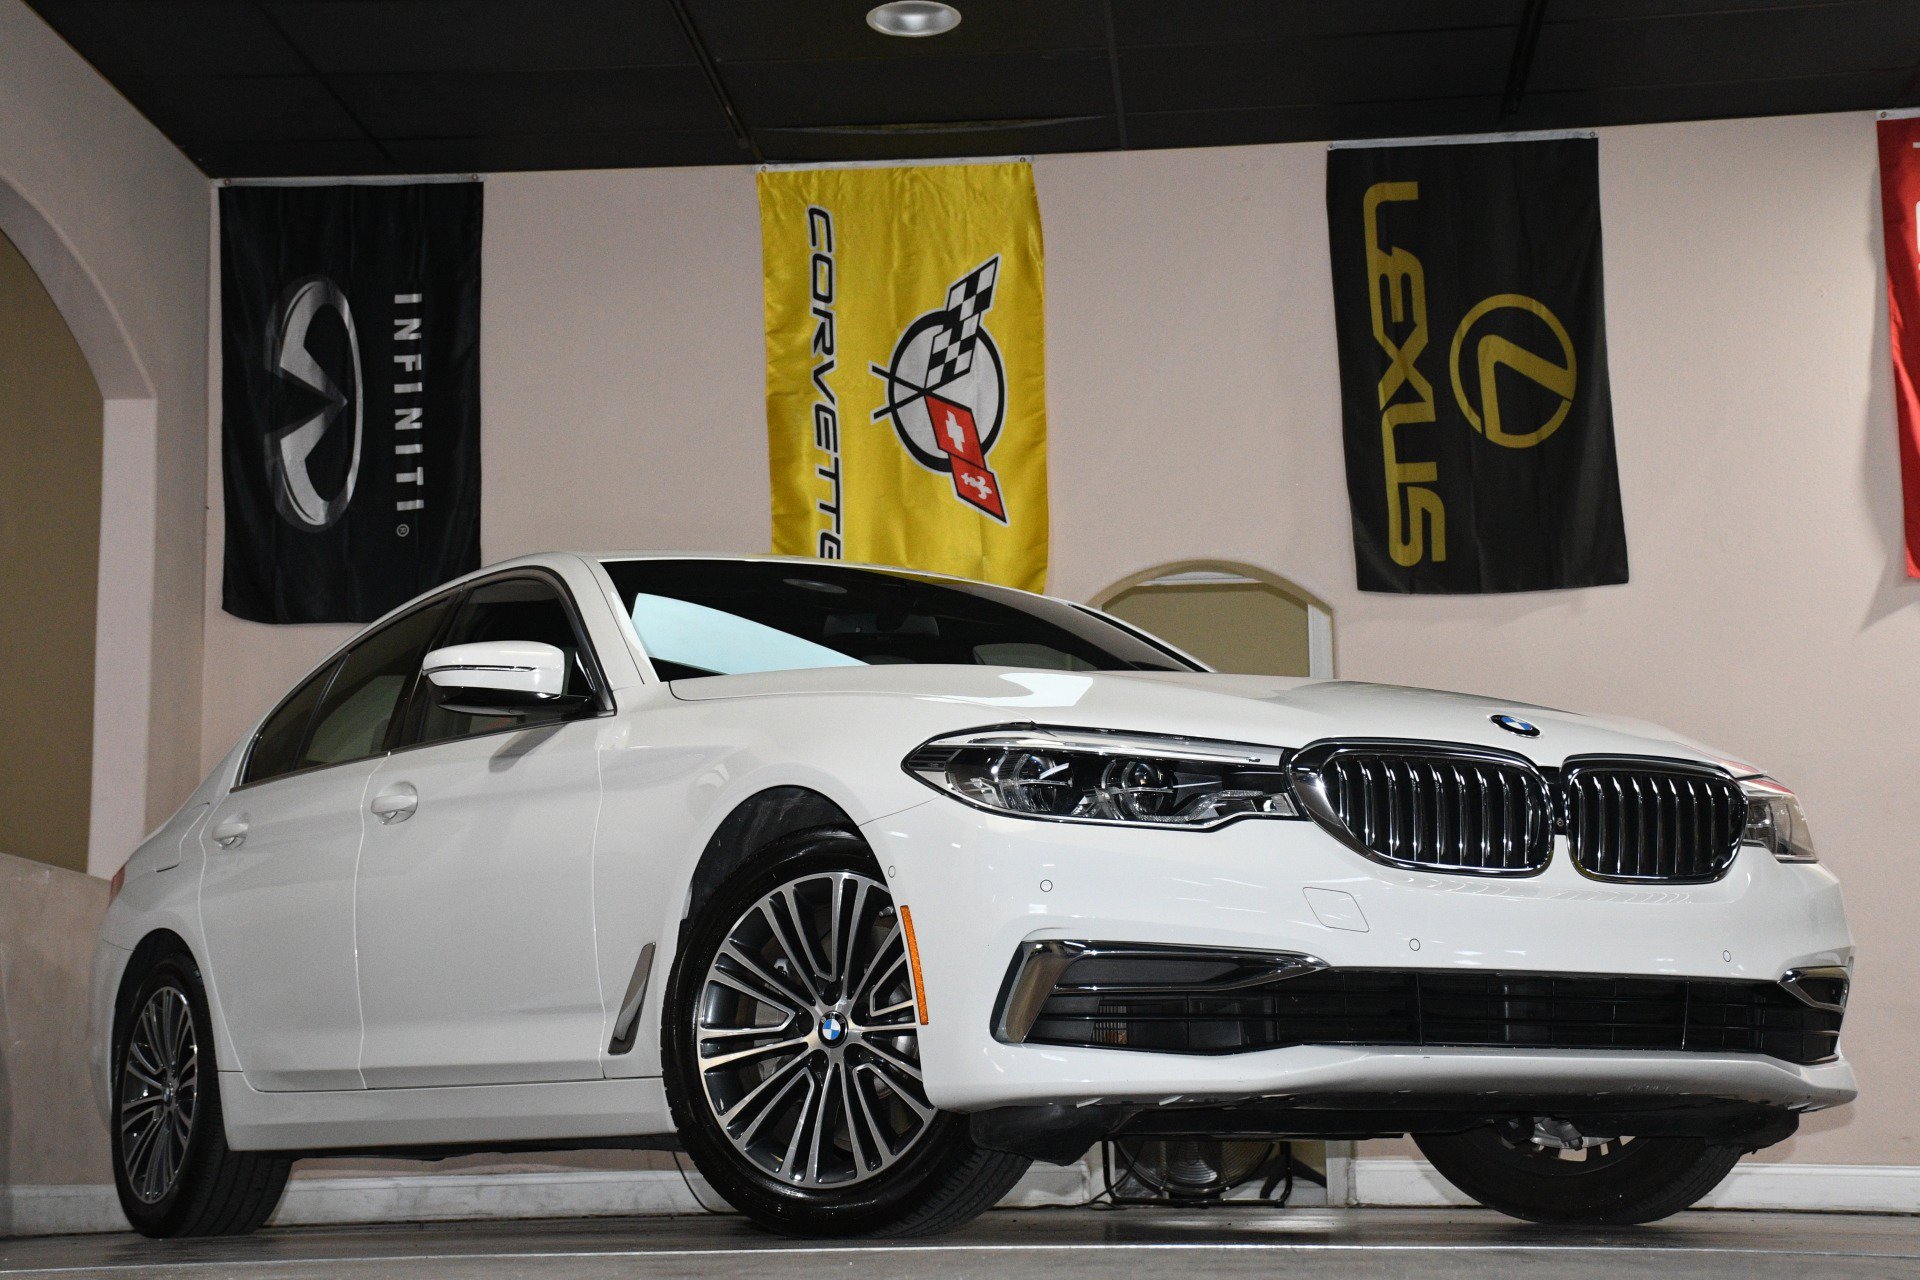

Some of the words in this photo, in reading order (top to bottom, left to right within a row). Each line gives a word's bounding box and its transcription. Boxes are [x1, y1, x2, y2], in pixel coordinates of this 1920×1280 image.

[394, 293, 425, 511] INFINITI
[807, 206, 842, 559] CORVETTE
[1363, 181, 1446, 567] LEXUS
